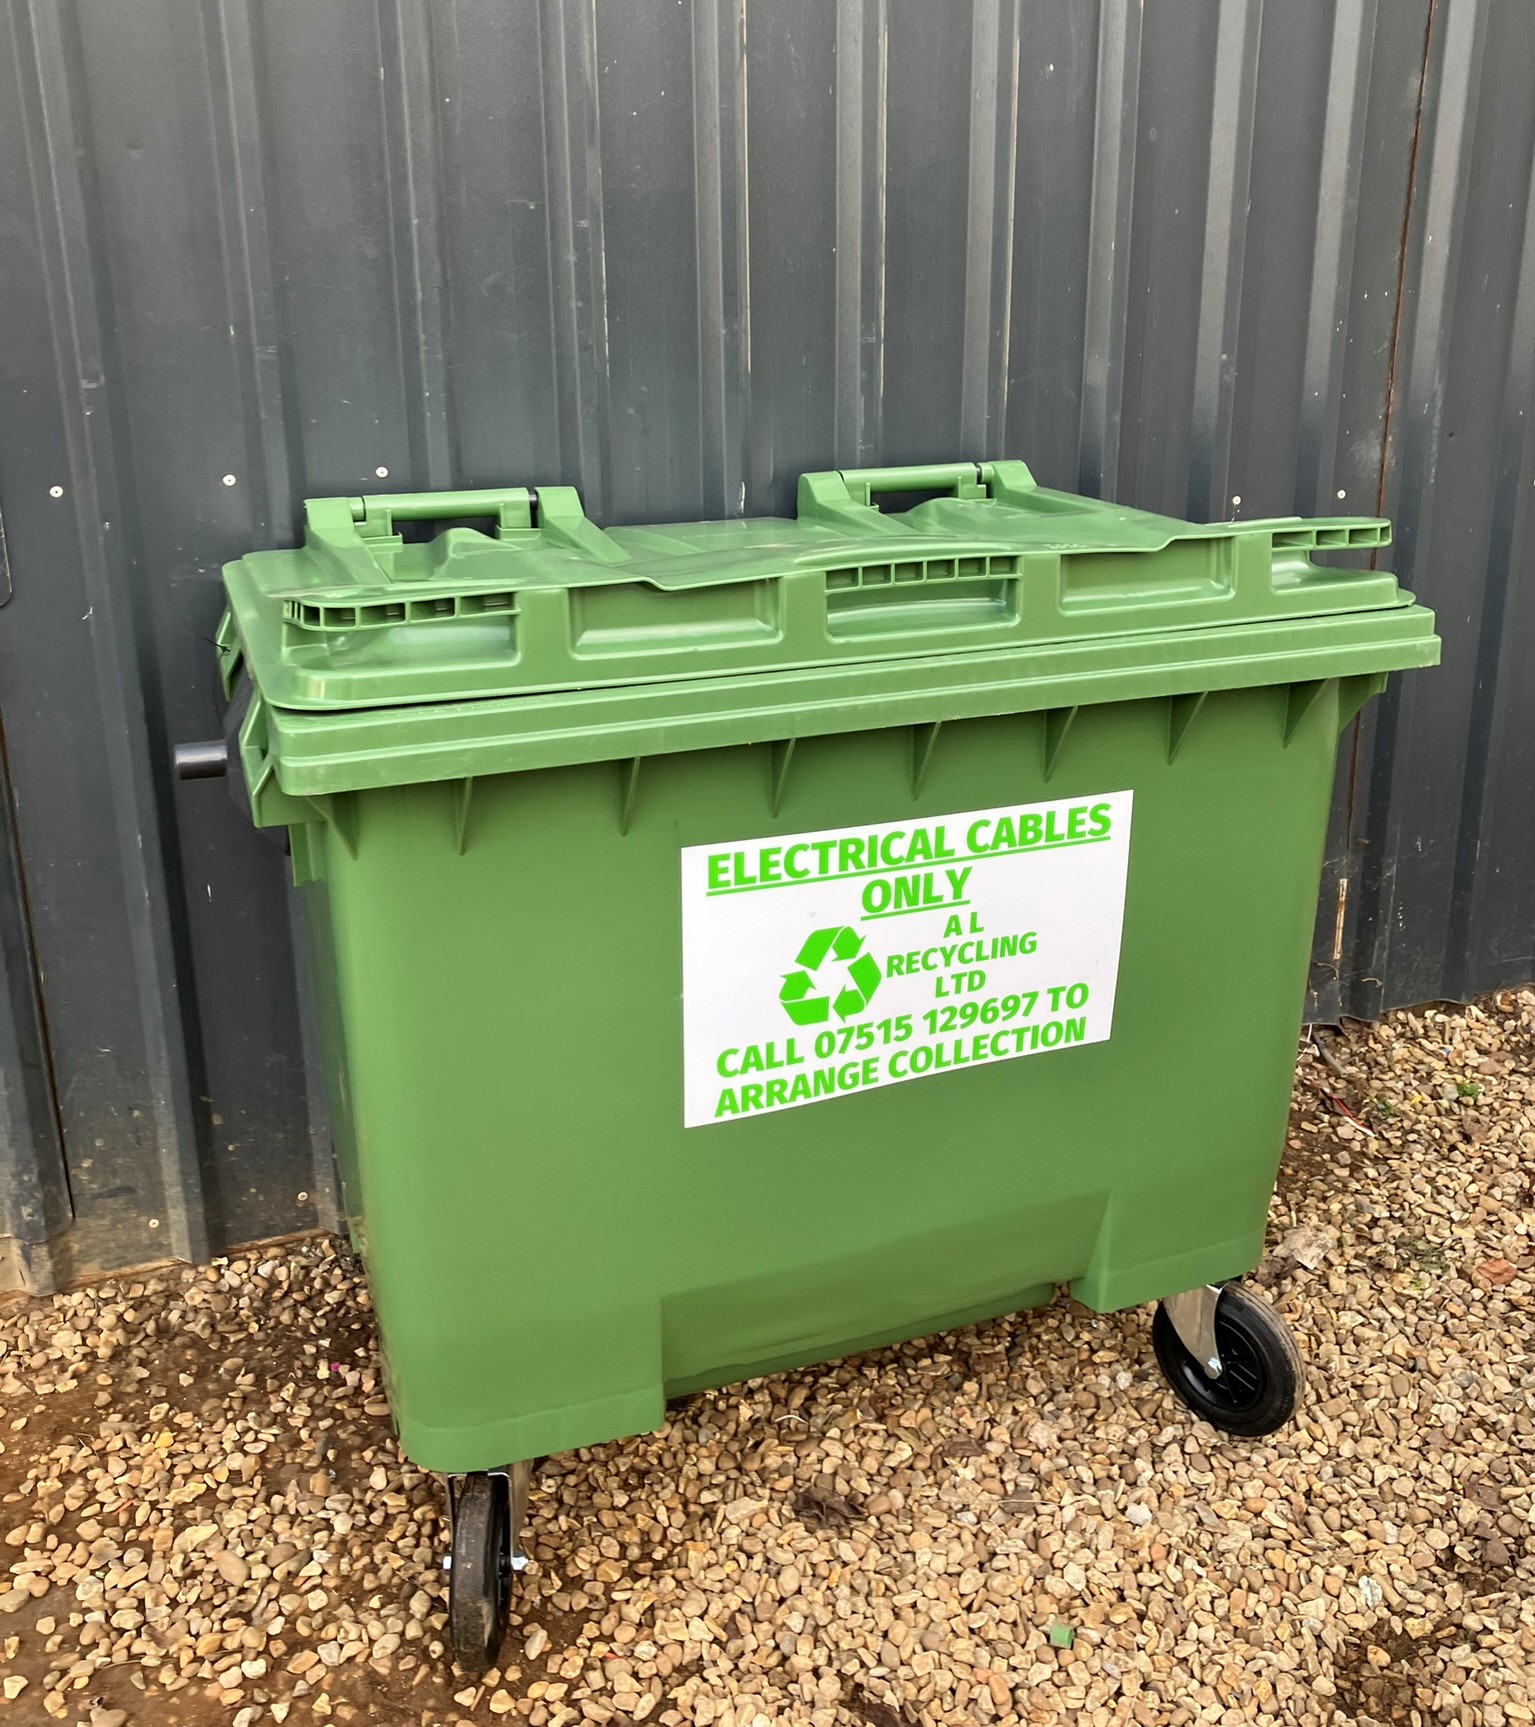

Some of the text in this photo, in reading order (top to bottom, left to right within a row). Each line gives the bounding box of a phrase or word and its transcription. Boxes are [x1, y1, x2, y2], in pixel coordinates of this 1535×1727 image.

[707, 803, 1112, 892] ELECTRICAL CABLES
[861, 866, 972, 916] ONLY
[943, 911, 985, 938] A L
[886, 931, 1038, 978] RECYCLING
[935, 970, 987, 998] LTD
[716, 982, 1089, 1078] CALL 07515 129697 TO
[714, 1017, 1087, 1118] ARRANGE COLLECTION
